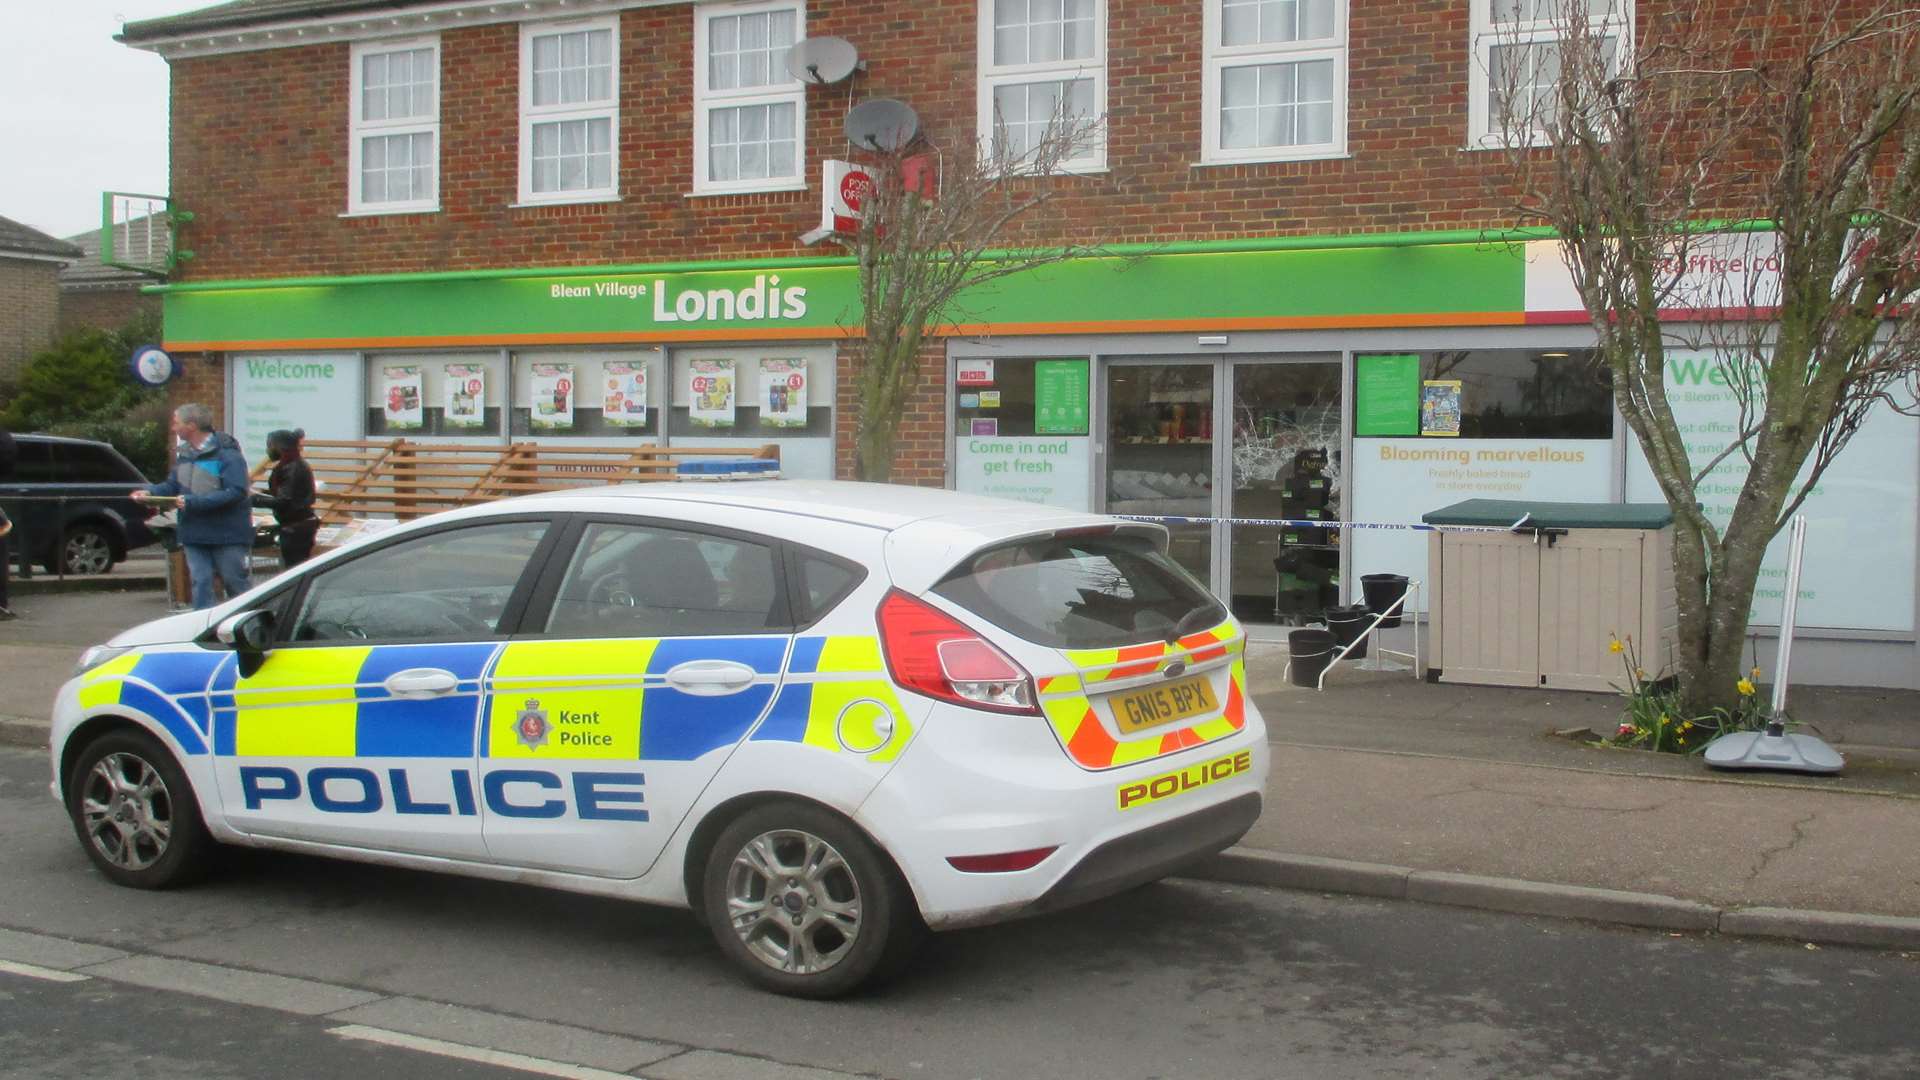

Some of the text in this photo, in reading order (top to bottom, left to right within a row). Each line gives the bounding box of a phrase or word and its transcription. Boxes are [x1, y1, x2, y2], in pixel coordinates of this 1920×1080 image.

[551, 283, 647, 299] Blean Village
[654, 275, 807, 322] Londis
[247, 360, 335, 378] Welcome
[1698, 421, 1735, 433] office
[970, 440, 1068, 454] Come in and
[1380, 446, 1585, 464] Blooming marvellous
[984, 459, 1053, 475] get fresh
[1124, 681, 1209, 726] GN15 BPX
[560, 711, 600, 725] Kent
[560, 732, 613, 746] Police
[1119, 751, 1250, 809] POLICE
[239, 766, 650, 822] POLICE
